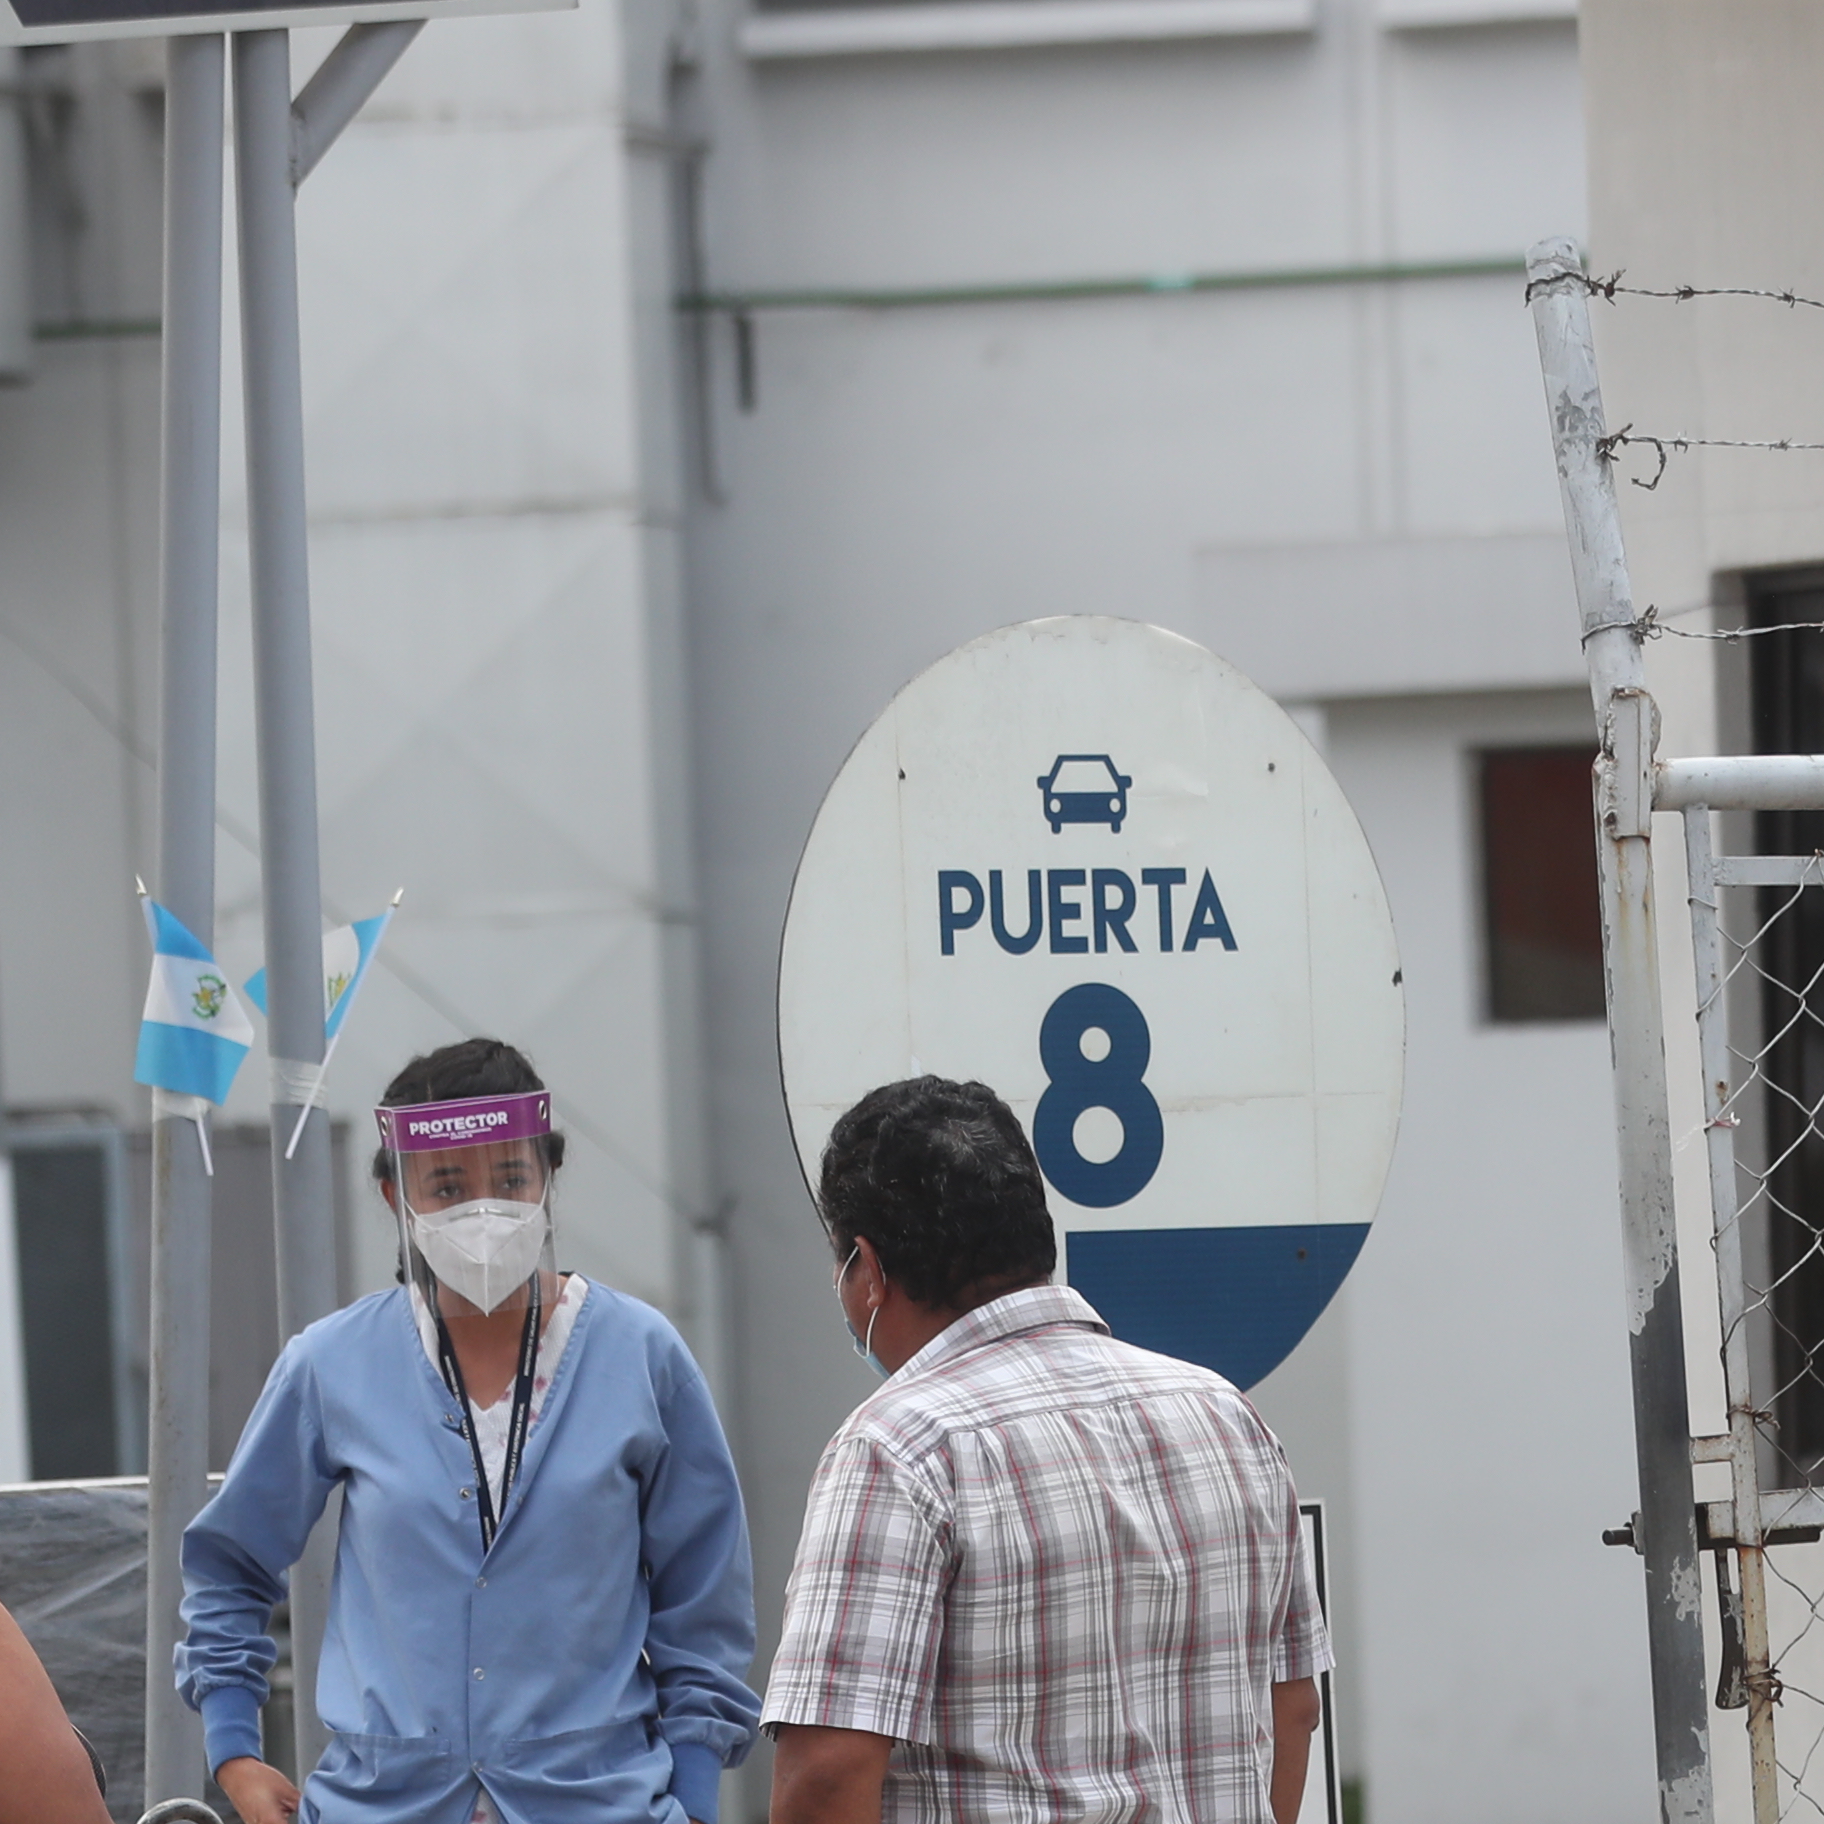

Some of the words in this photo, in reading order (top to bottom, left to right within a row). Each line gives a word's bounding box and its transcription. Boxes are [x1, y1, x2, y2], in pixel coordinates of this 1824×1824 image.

[938, 867, 1239, 956] PUERTA
[409, 1111, 509, 1136] PROTECTOR
[1033, 982, 1164, 1209] 8
